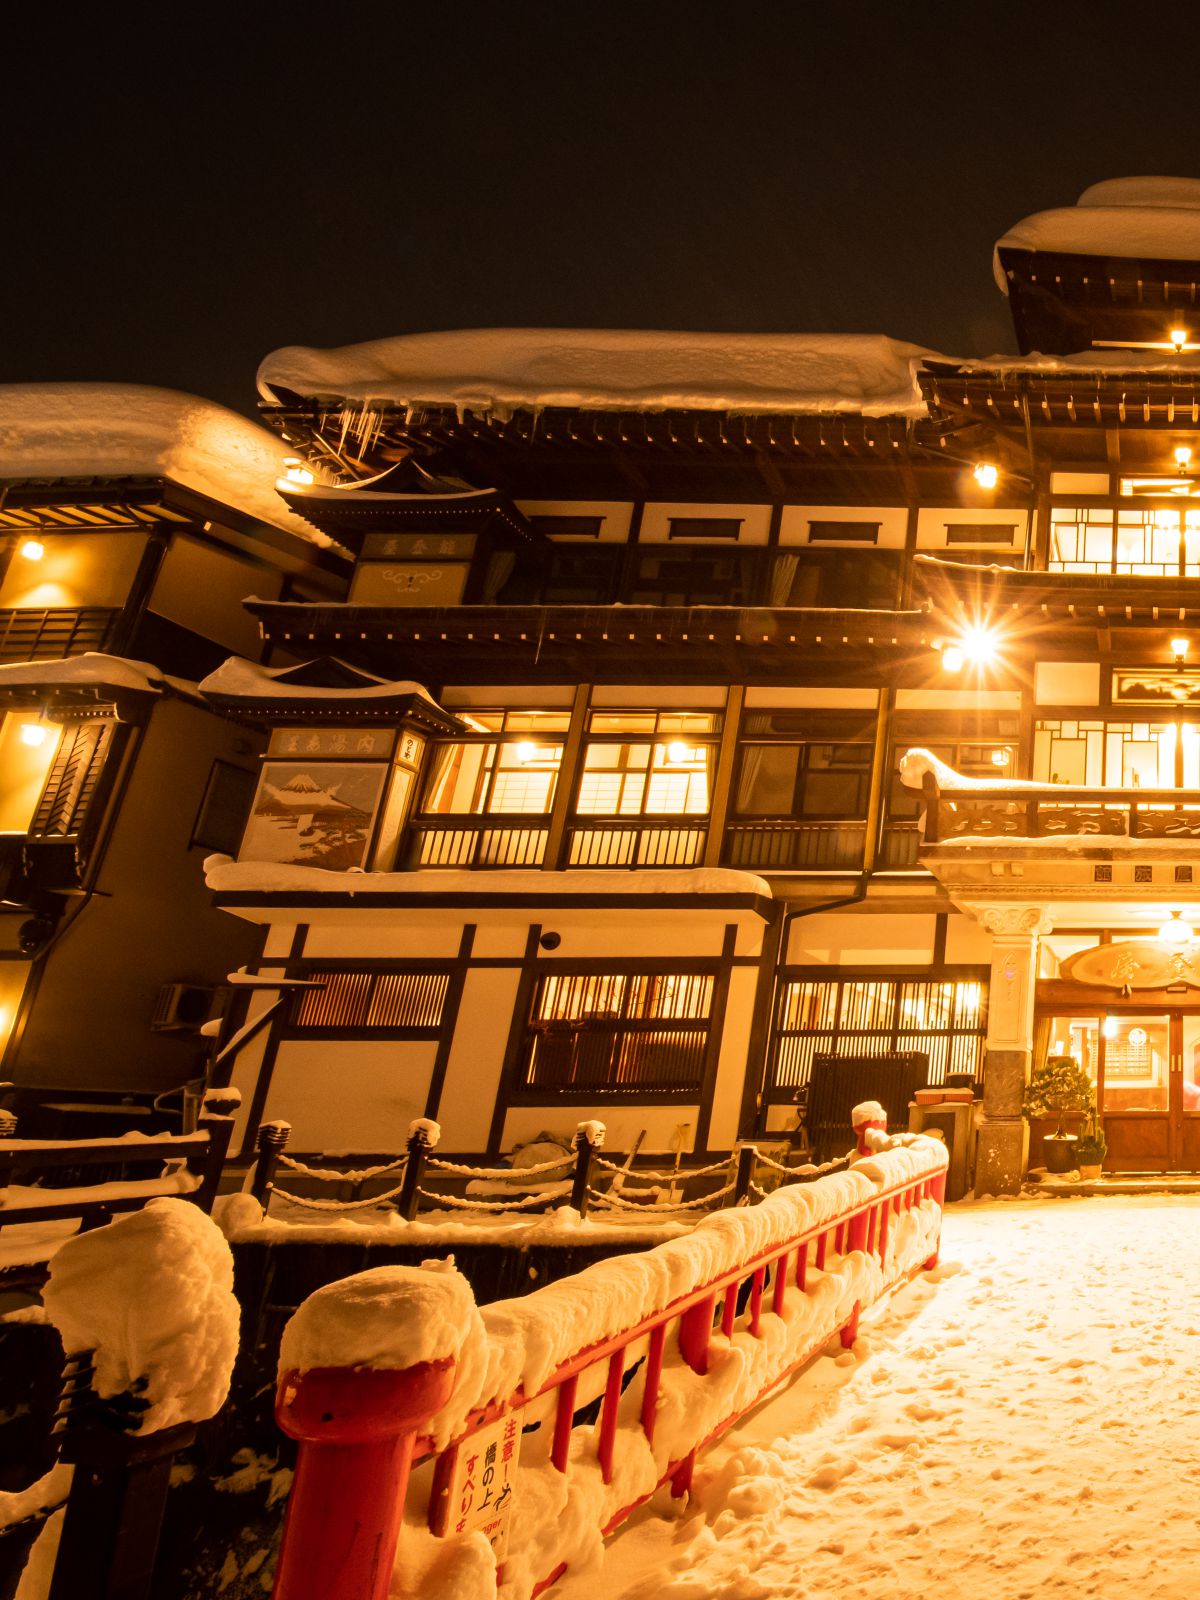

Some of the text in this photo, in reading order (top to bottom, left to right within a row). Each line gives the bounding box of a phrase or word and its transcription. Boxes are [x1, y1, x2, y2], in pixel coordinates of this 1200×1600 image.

[476, 1441, 498, 1512] 橋の上
[481, 1518, 502, 1535] nger
